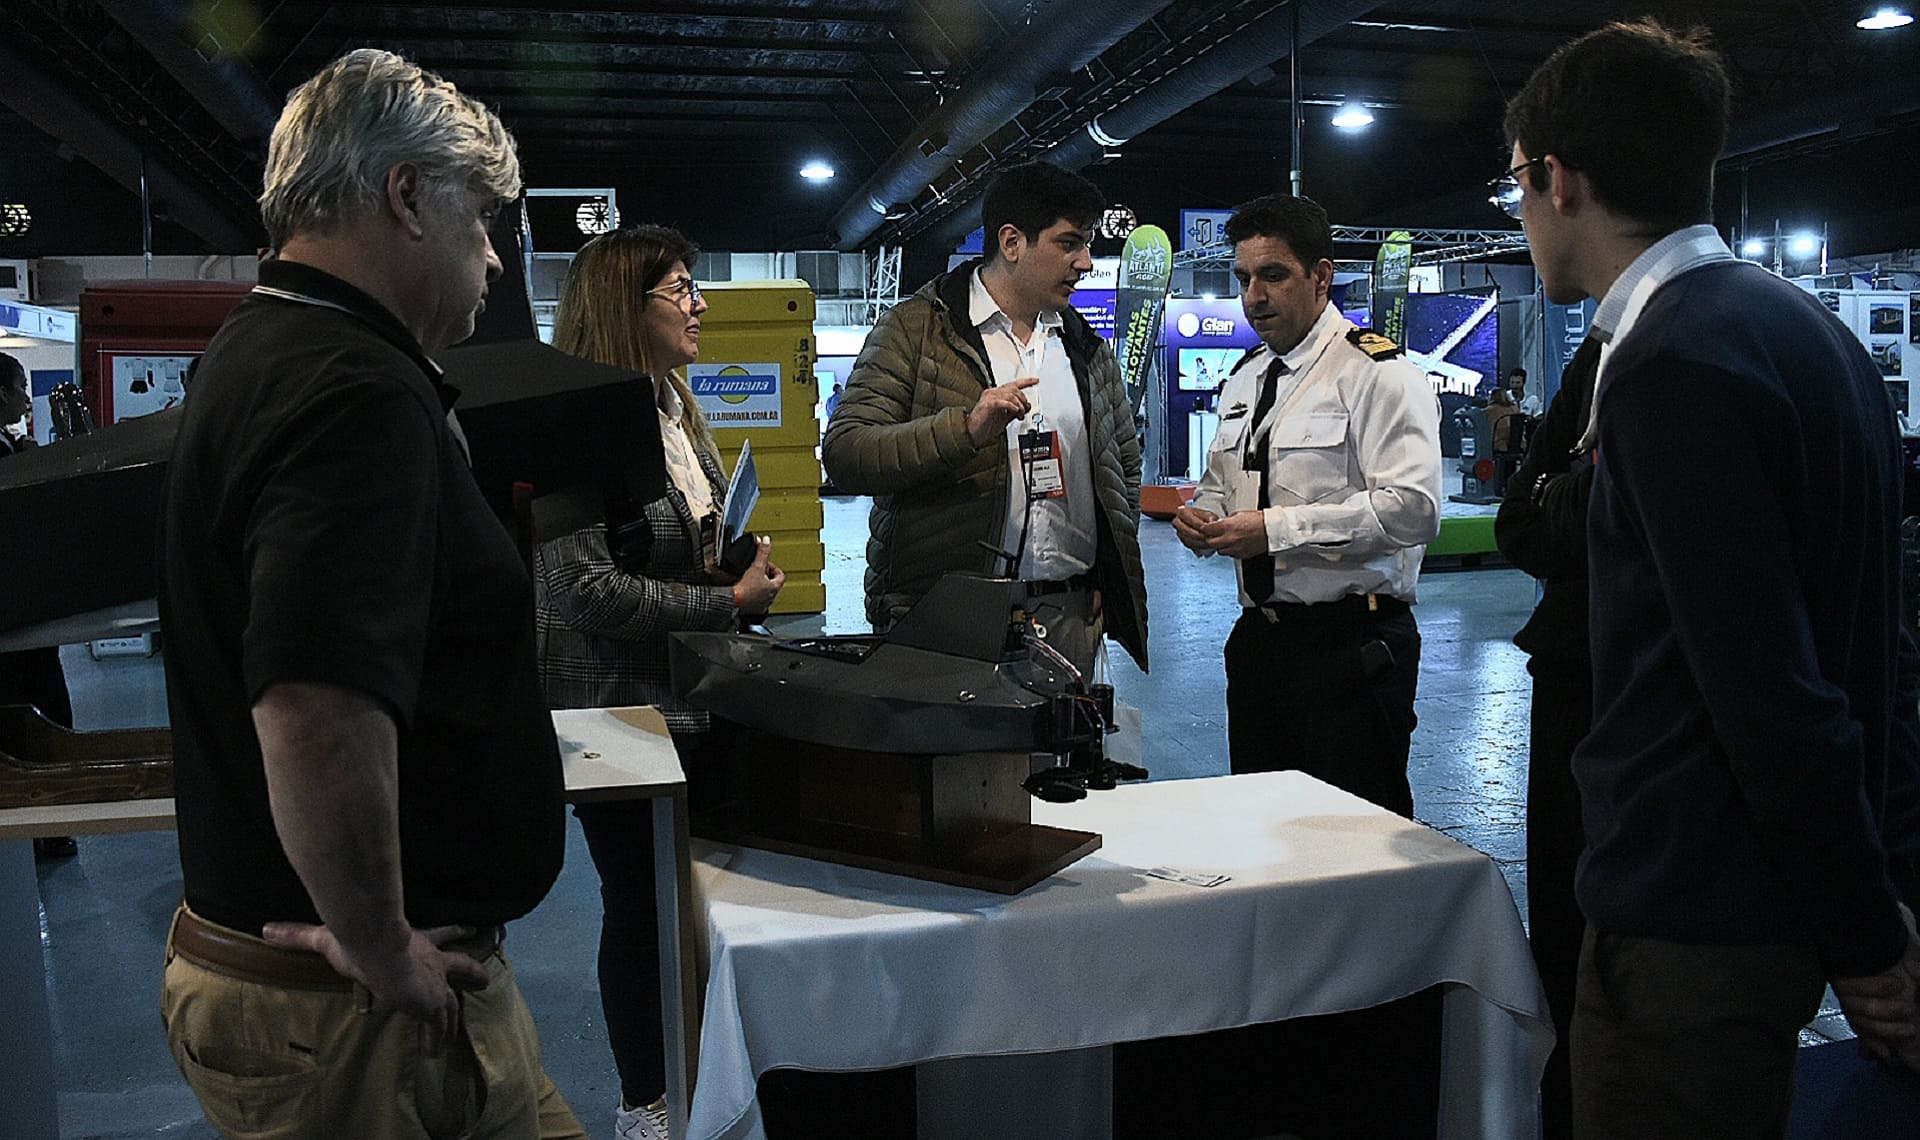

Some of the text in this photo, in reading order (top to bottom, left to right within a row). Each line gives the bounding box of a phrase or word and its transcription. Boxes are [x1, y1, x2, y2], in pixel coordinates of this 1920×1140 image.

[1202, 316, 1235, 332] Glan
[1391, 297, 1401, 342] ANTES
[1126, 298, 1152, 385] FLOTANTES
[697, 377, 770, 392] la rumana
